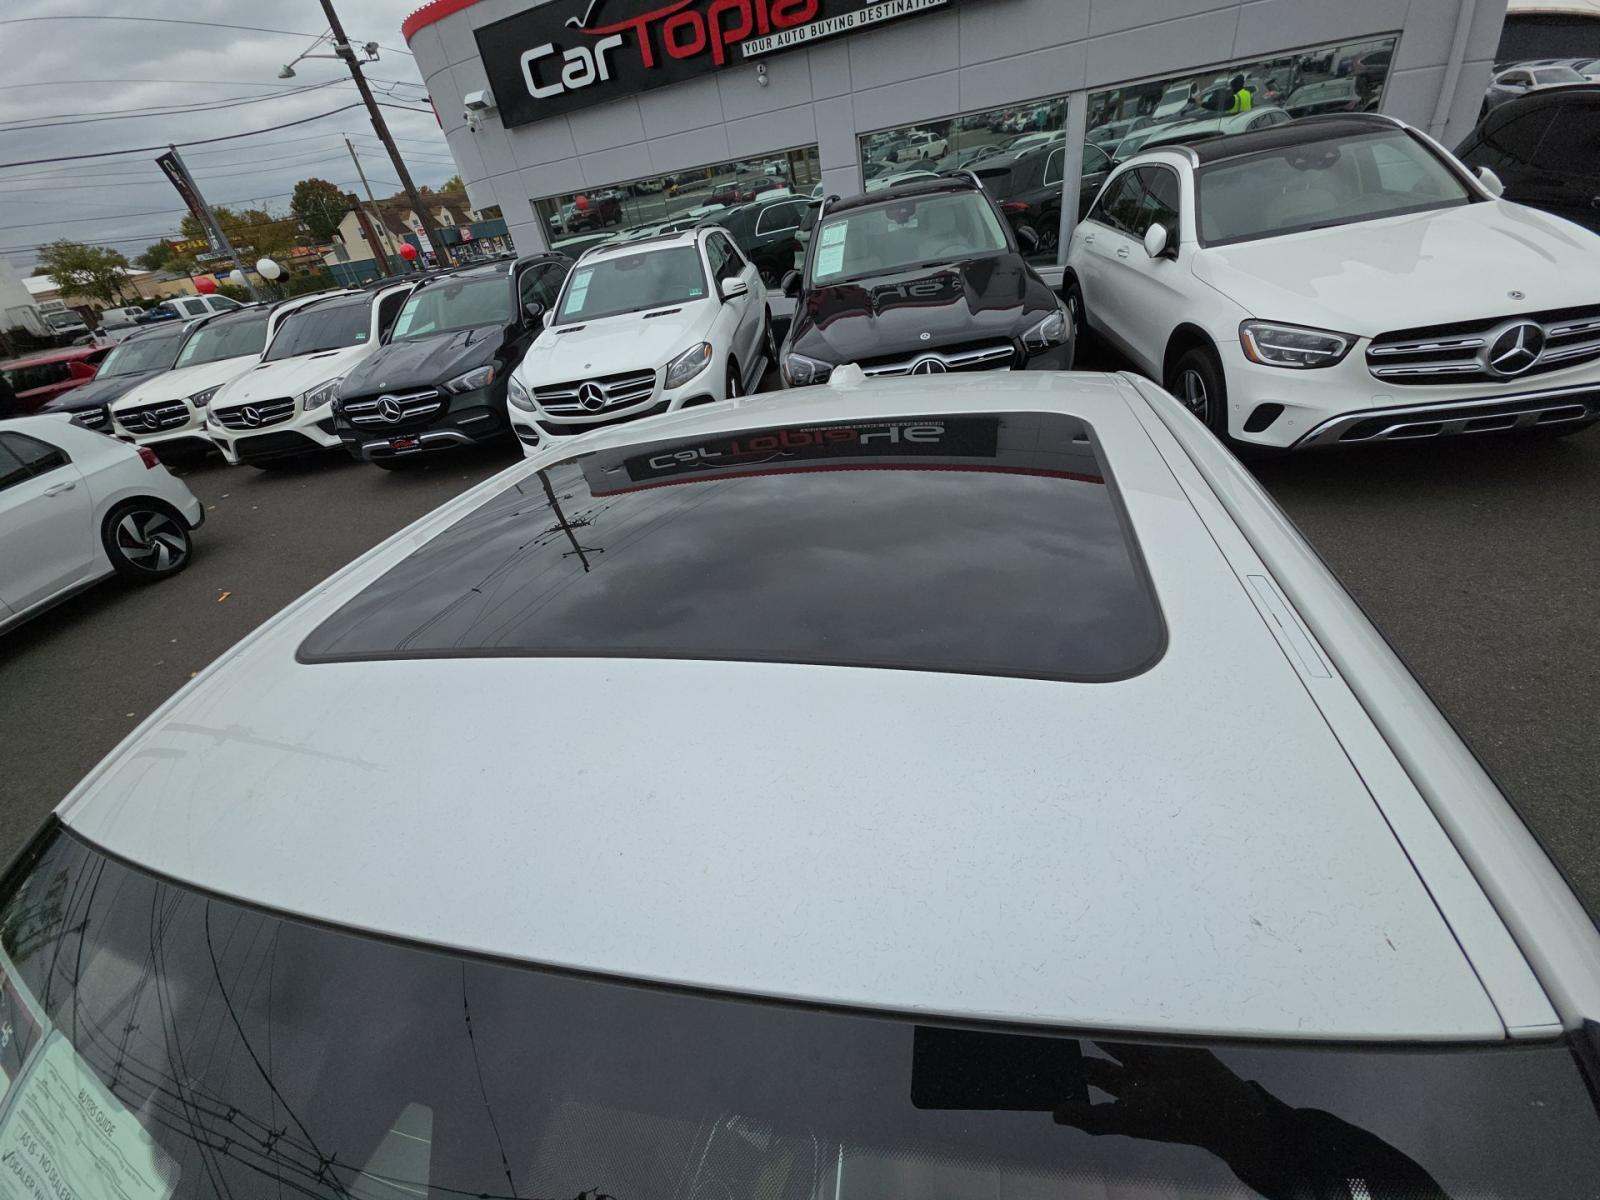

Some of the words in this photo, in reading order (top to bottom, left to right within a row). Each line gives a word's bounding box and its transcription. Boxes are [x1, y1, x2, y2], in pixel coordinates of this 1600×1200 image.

[744, 40, 773, 56] YOUR
[777, 28, 806, 45] AUTO
[810, 15, 855, 36] BUYING
[96, 1110, 117, 1137] GUIDE
[39, 1153, 52, 1173] NO
